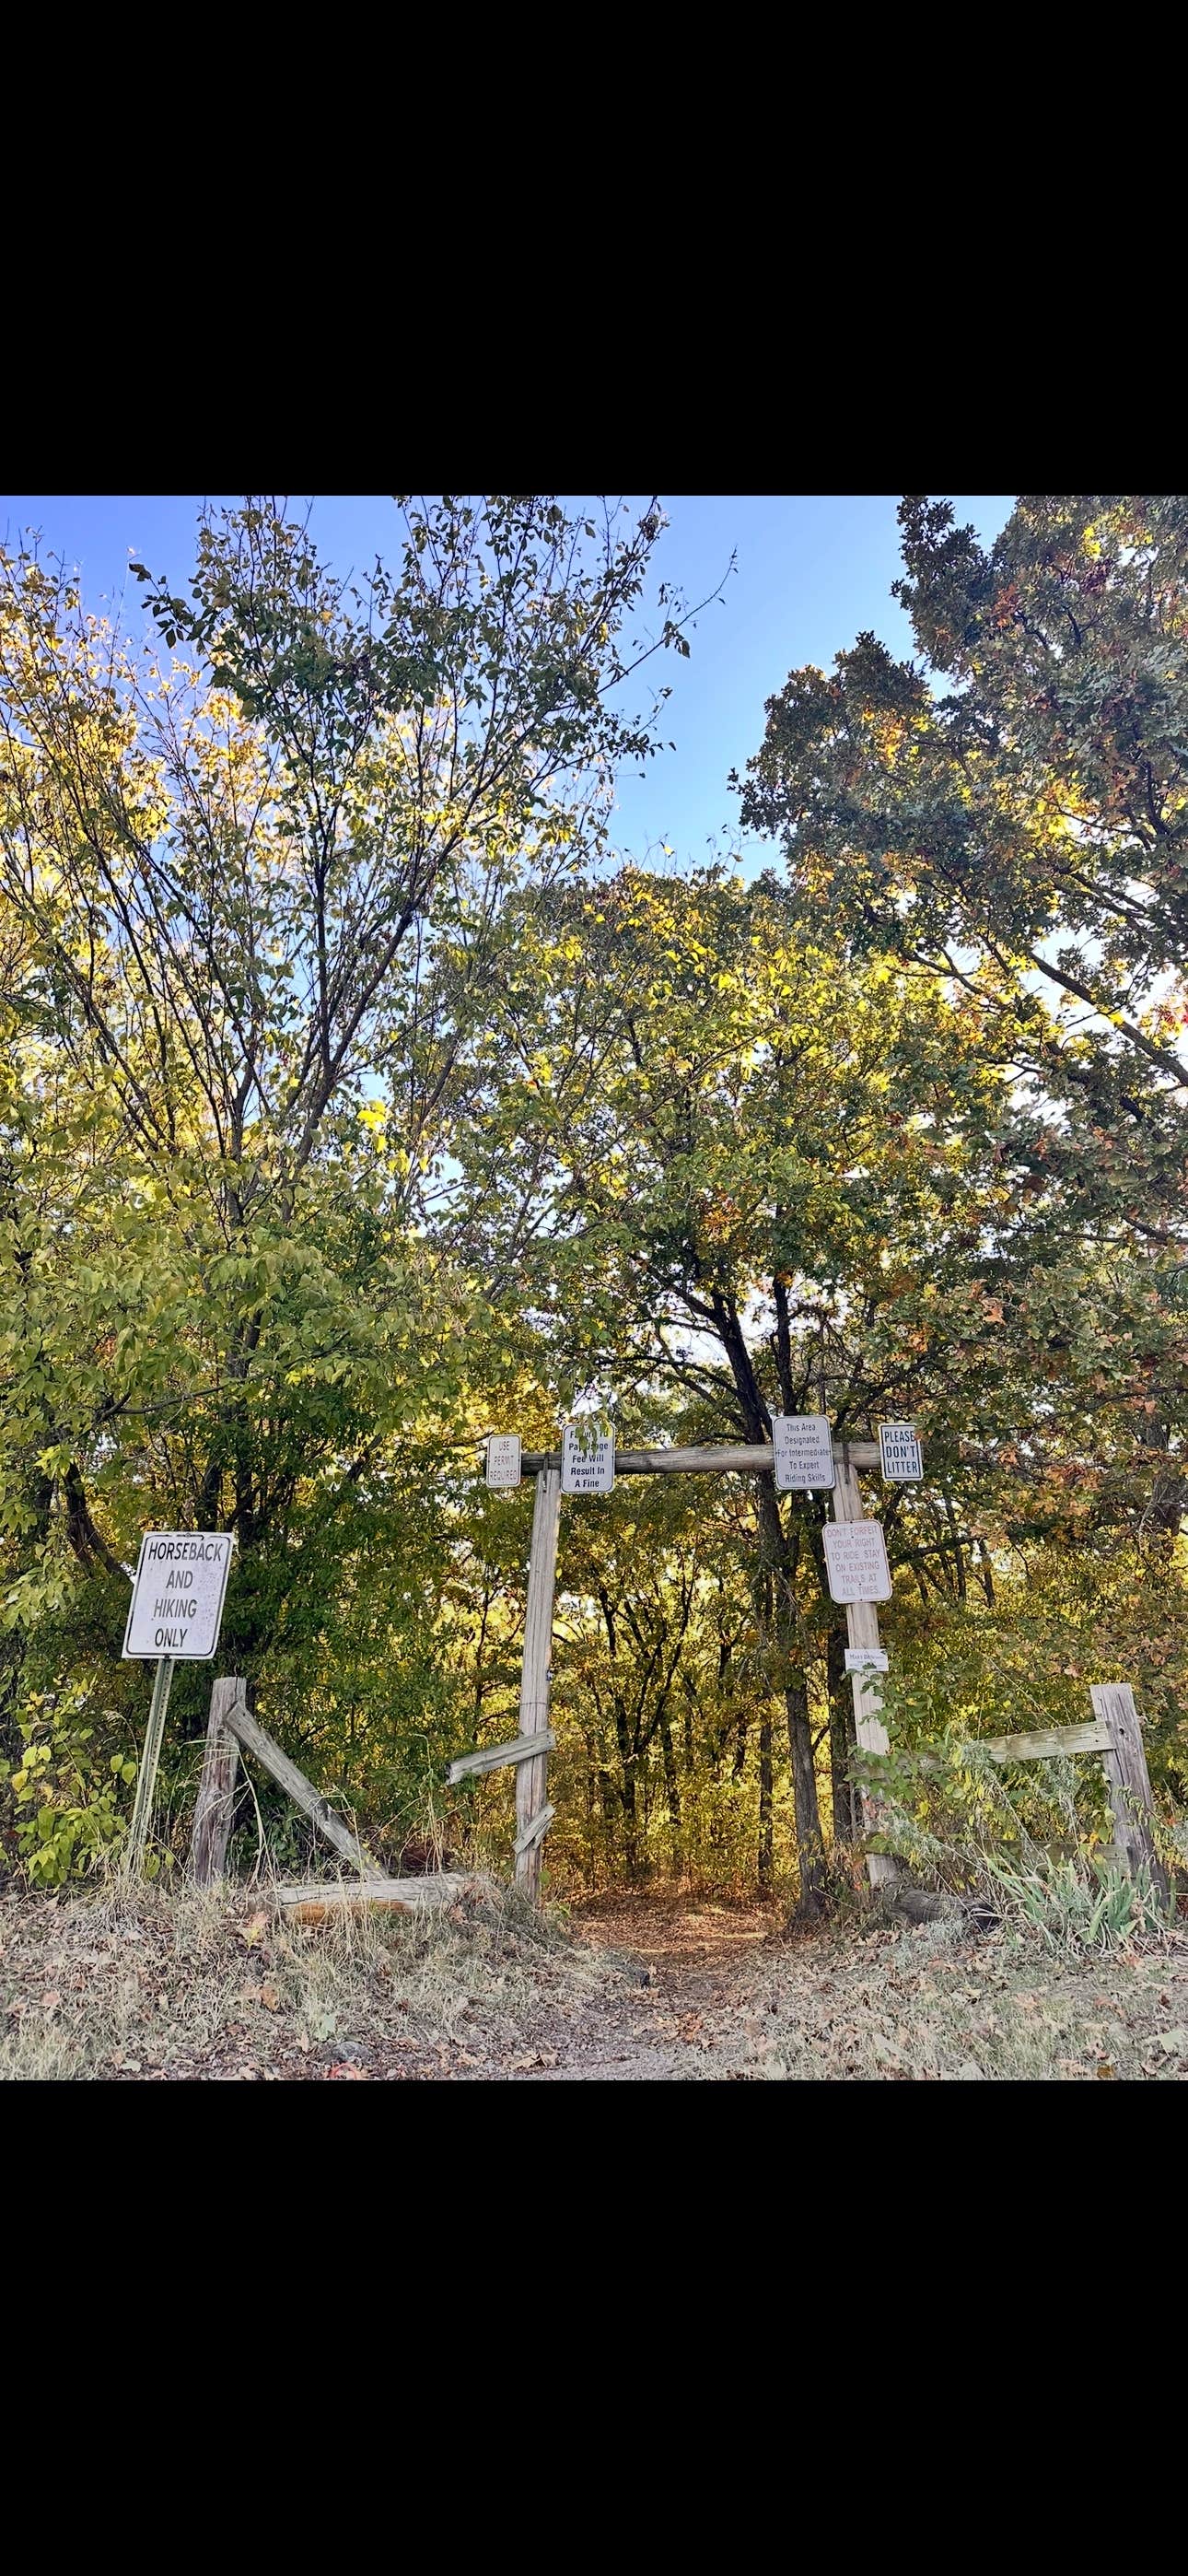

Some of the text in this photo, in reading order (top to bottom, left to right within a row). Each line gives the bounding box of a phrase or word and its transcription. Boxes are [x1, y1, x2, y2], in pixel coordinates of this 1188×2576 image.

[786, 1423, 799, 1432] This
[784, 1435, 820, 1446] Designated
[884, 1431, 915, 1443] PLEASE
[788, 1448, 829, 1457] Intermediate
[886, 1446, 915, 1458] DON'T
[572, 1454, 604, 1463] Fee Will
[789, 1461, 820, 1469] To Expert
[887, 1461, 918, 1473] LITTER
[571, 1467, 605, 1475] Result In
[575, 1479, 600, 1488] A Fine
[785, 1474, 826, 1483] Riding Skills
[833, 1538, 875, 1549] YOUR RIGHT
[147, 1542, 223, 1562] HORSEBACK
[830, 1551, 841, 1561] TO
[864, 1549, 880, 1558] STAY
[835, 1561, 880, 1572] ON EXISTING
[166, 1570, 193, 1588] AND
[841, 1574, 877, 1584] TRAILS AT
[153, 1598, 198, 1619] HIKING
[155, 1628, 188, 1647] ONLY
